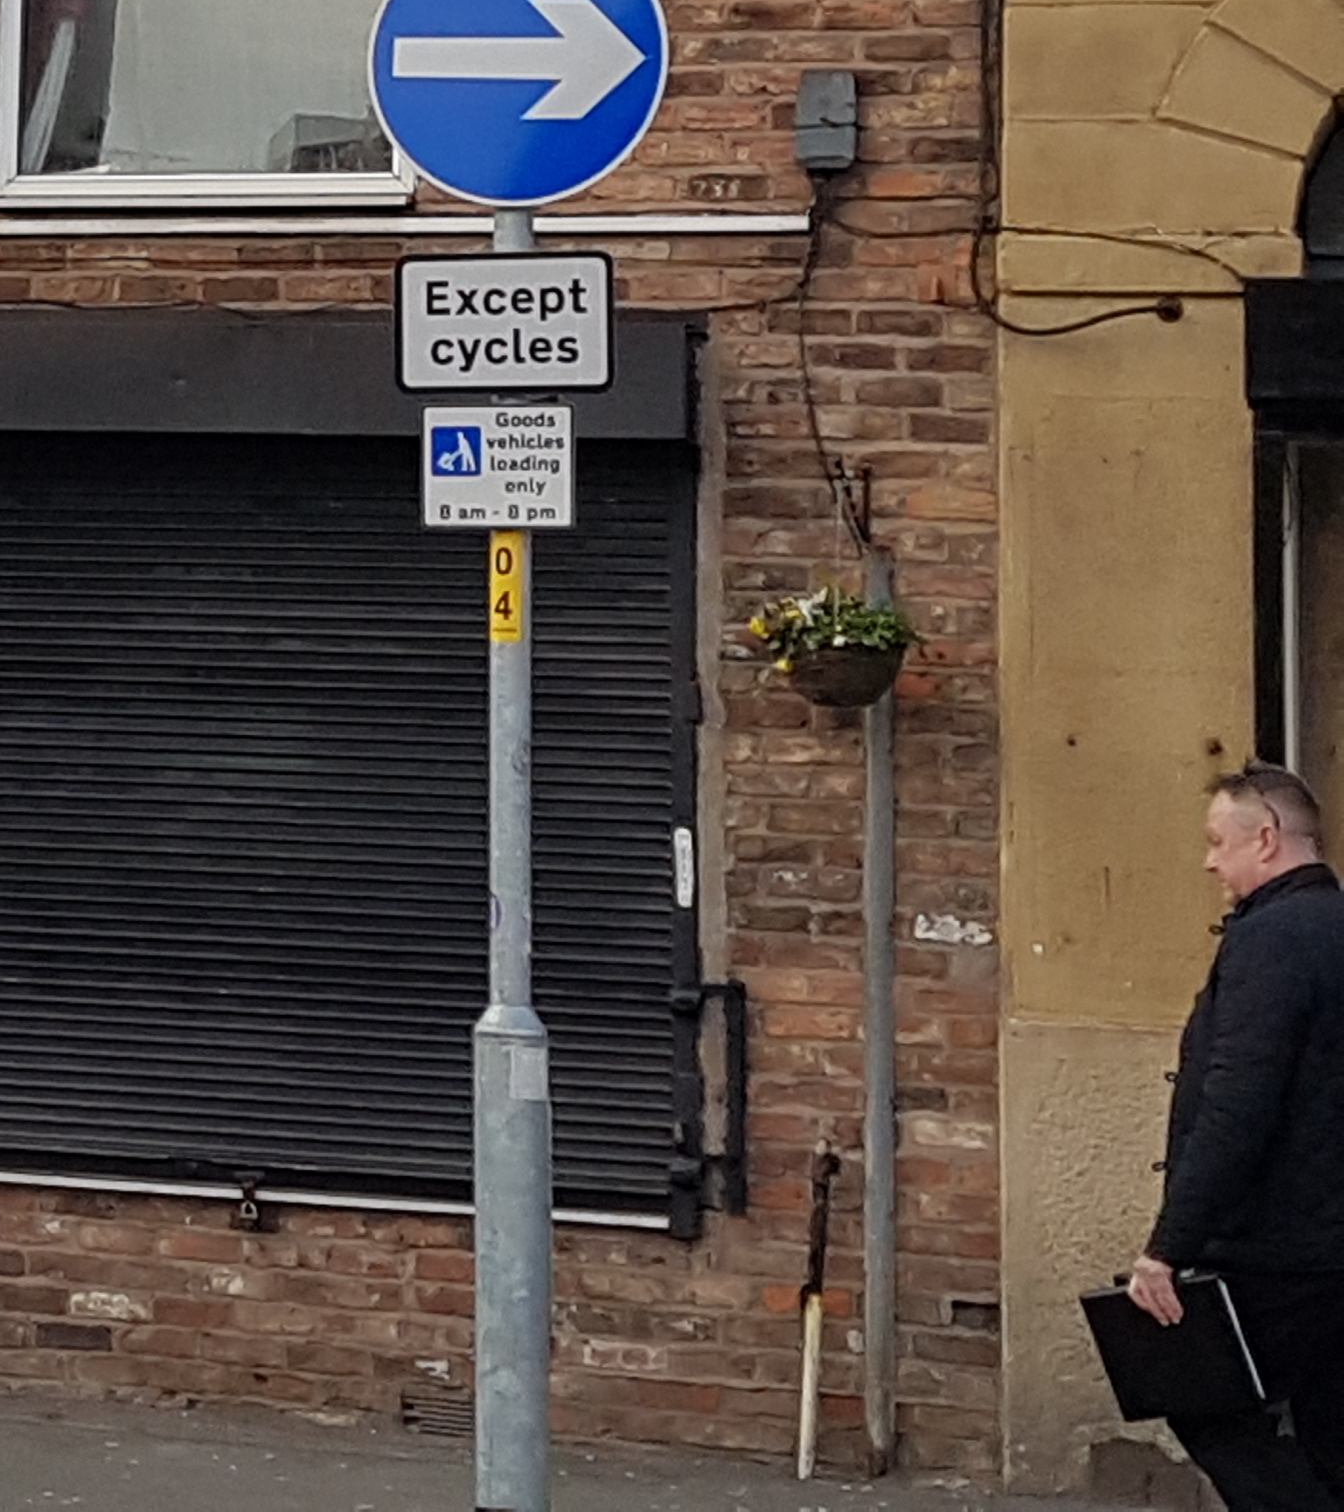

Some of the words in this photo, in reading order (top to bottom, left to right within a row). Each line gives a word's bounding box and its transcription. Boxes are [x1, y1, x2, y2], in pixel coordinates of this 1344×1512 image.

[425, 279, 589, 322] Except
[430, 328, 580, 372] cycles
[495, 412, 556, 428] Goods
[486, 434, 565, 450] vehicles
[489, 456, 560, 474] loading
[505, 478, 547, 495] only
[458, 507, 486, 520] am
[526, 506, 556, 522] pm
